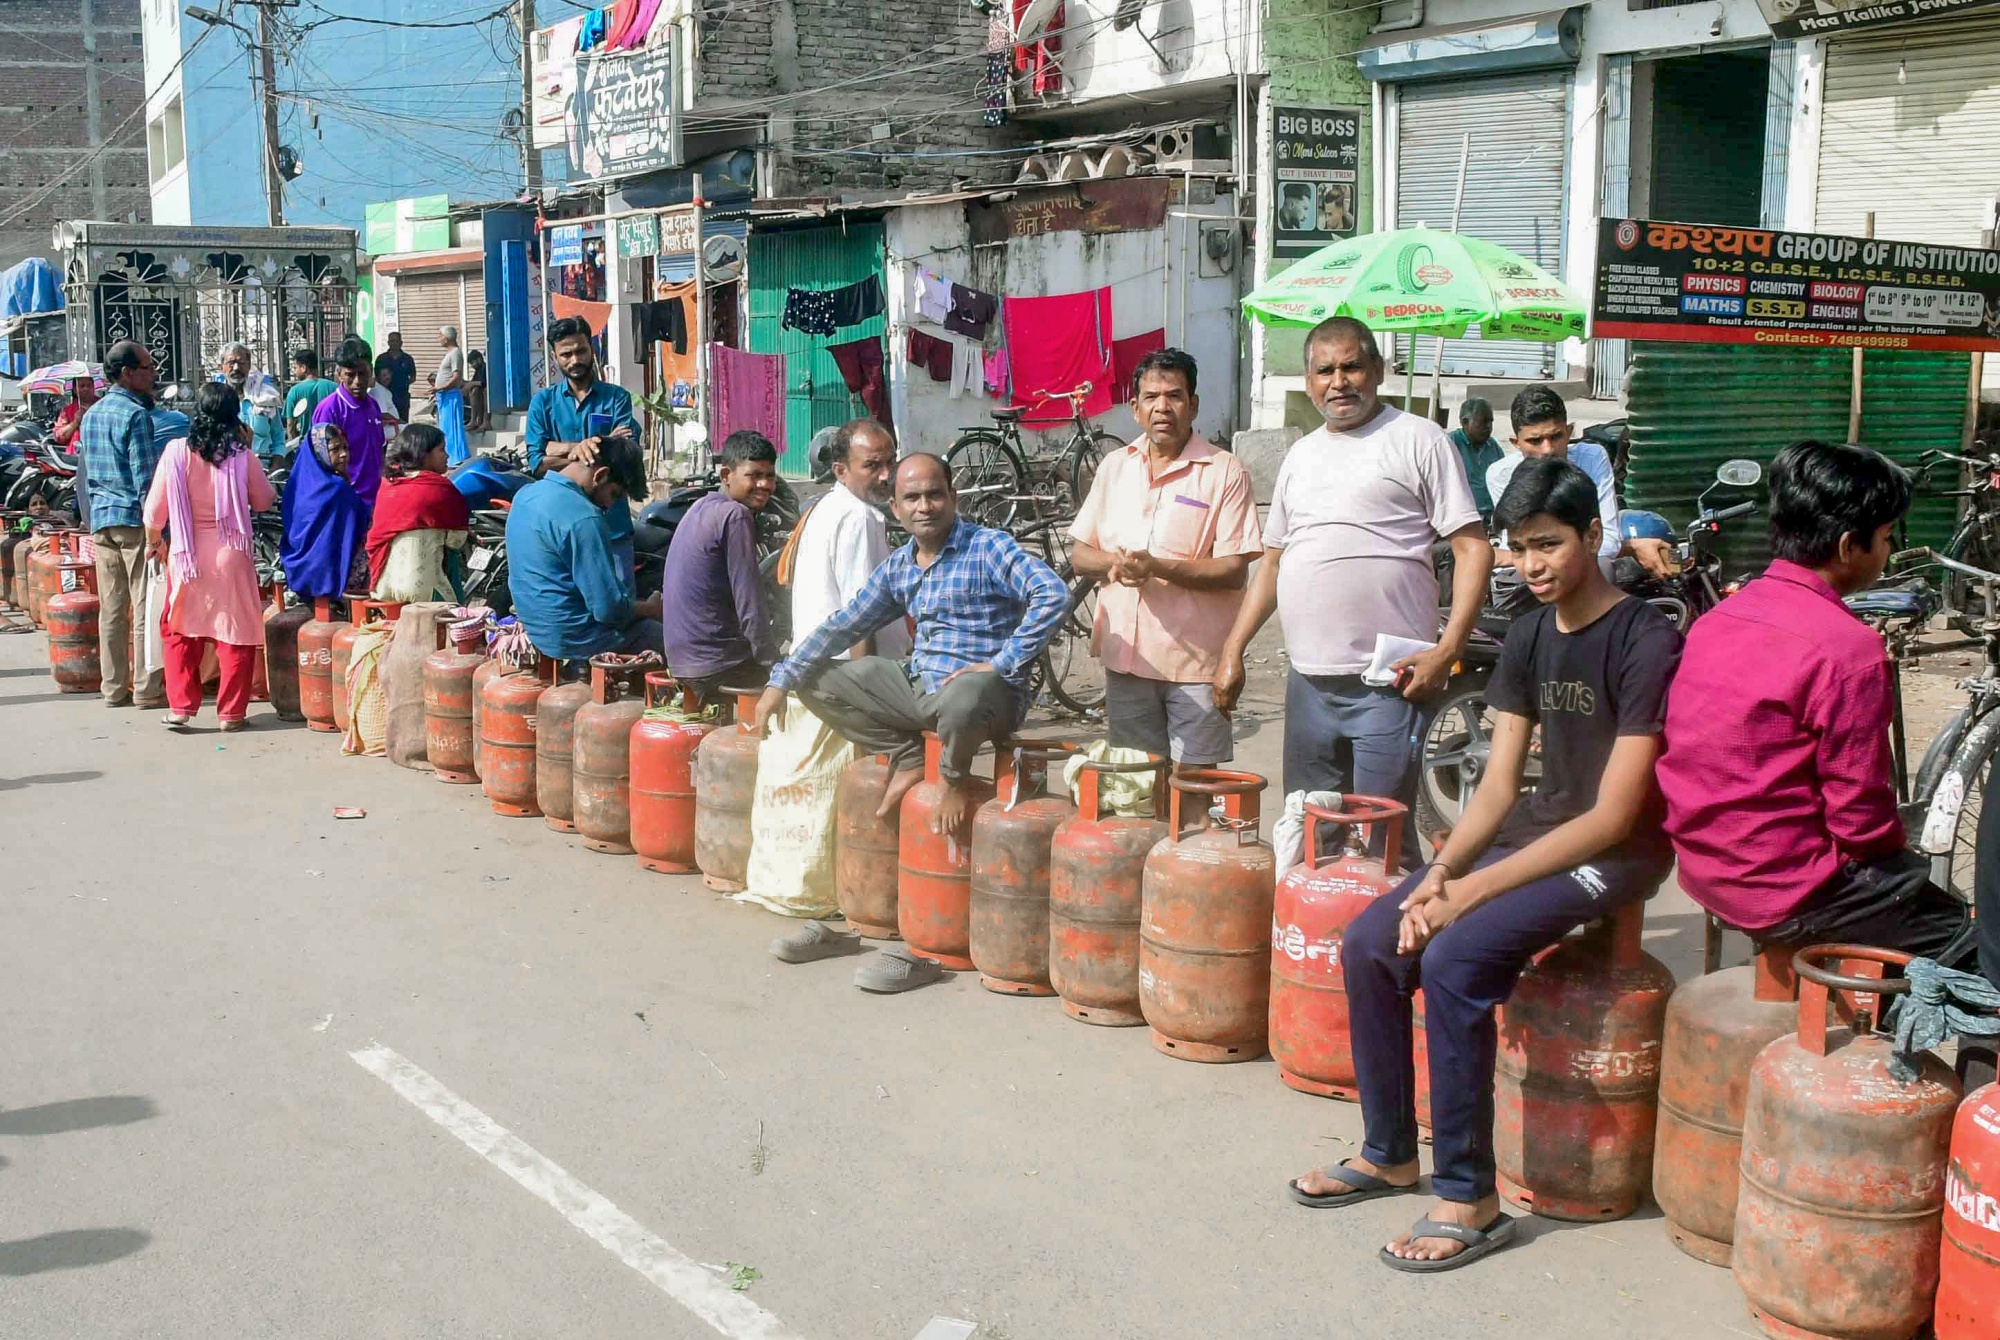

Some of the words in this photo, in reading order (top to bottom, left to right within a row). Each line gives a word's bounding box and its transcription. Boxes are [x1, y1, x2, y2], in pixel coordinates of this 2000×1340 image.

[1799, 16, 1840, 31] Maa
[1844, 6, 1905, 24] Kalika
[1908, 0, 1974, 14] Jew
[1278, 116, 1308, 135] BIG
[1311, 118, 1355, 137] BOSS
[1280, 169, 1296, 177] CUT
[1302, 170, 1328, 178] SHAVE
[1334, 171, 1353, 179] TRIM
[1015, 212, 1039, 236] होता
[1041, 208, 1056, 231] है
[1647, 223, 1775, 258] कश्यप
[1777, 234, 1858, 263] GROUP
[1862, 243, 1891, 265] OF
[1894, 245, 2000, 274] INSTITUTIO
[1637, 266, 1659, 275] CLASSES
[1692, 257, 1745, 272] 10+2
[1750, 261, 1832, 280] C.B.S.E.,
[1906, 273, 1965, 287] B.S.E.B.
[1687, 276, 1741, 292] PHYSICS
[1750, 280, 1805, 296] CHEMISTRY
[1813, 285, 1861, 299] BIOLOGY
[1684, 297, 1740, 312] MATHS
[1878, 292, 1886, 304] to
[1913, 294, 1921, 307] to
[1751, 301, 1801, 315] S.S.T.
[1812, 304, 1858, 319] ENGLISH
[1708, 316, 1742, 326] Result
[1744, 318, 1786, 328] oriented
[1788, 321, 1844, 333] preparation
[1858, 326, 1873, 335] per
[1875, 325, 1889, 333] the
[1890, 326, 1915, 335] board
[1916, 327, 1946, 335] Pattern
